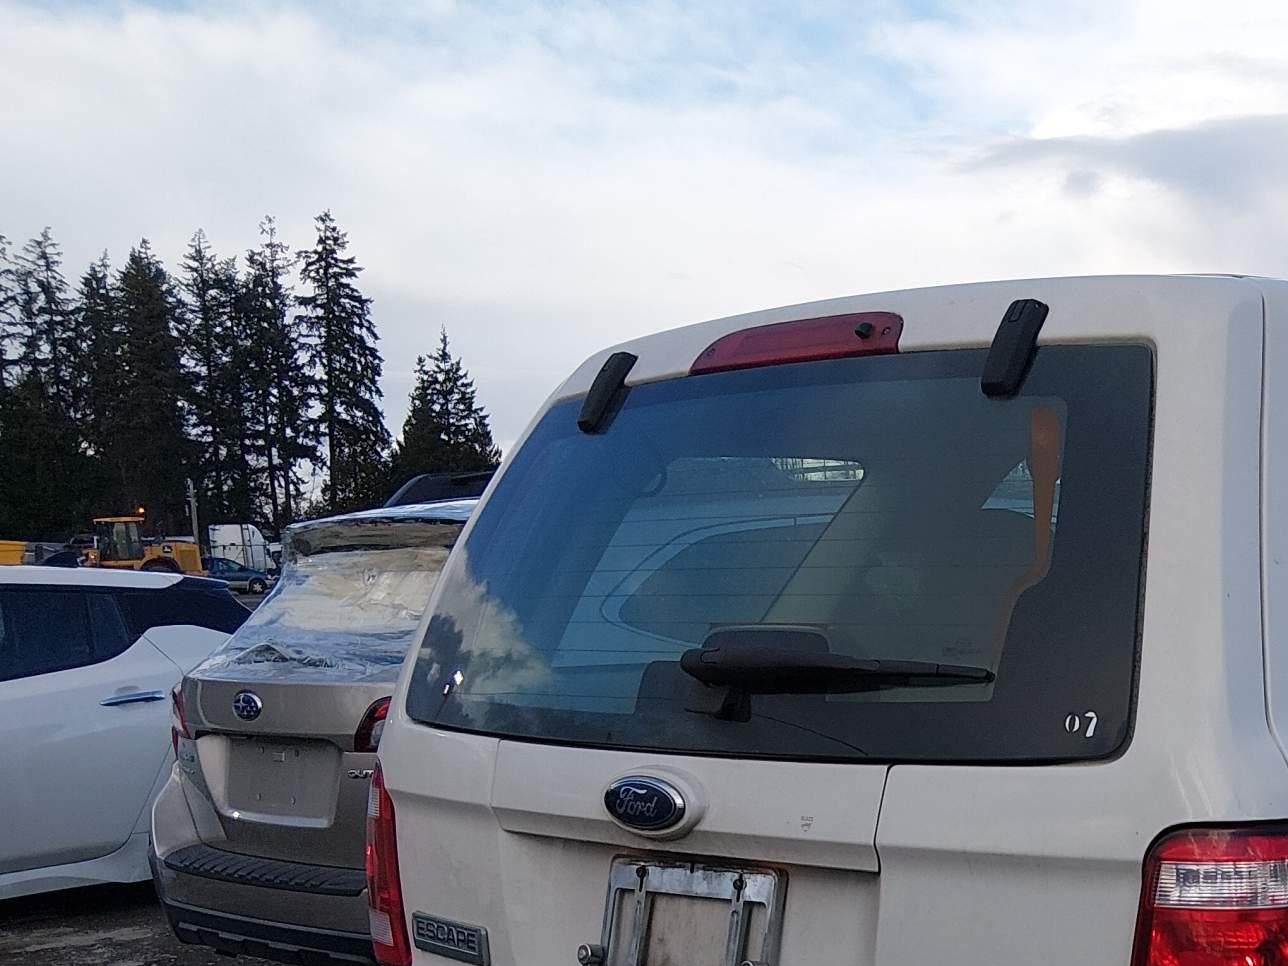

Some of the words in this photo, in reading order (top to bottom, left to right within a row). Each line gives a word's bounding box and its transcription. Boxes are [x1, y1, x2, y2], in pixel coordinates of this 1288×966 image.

[1065, 711, 1098, 738] 07
[615, 785, 658, 817] Ford
[416, 919, 479, 952] ESCAPE
